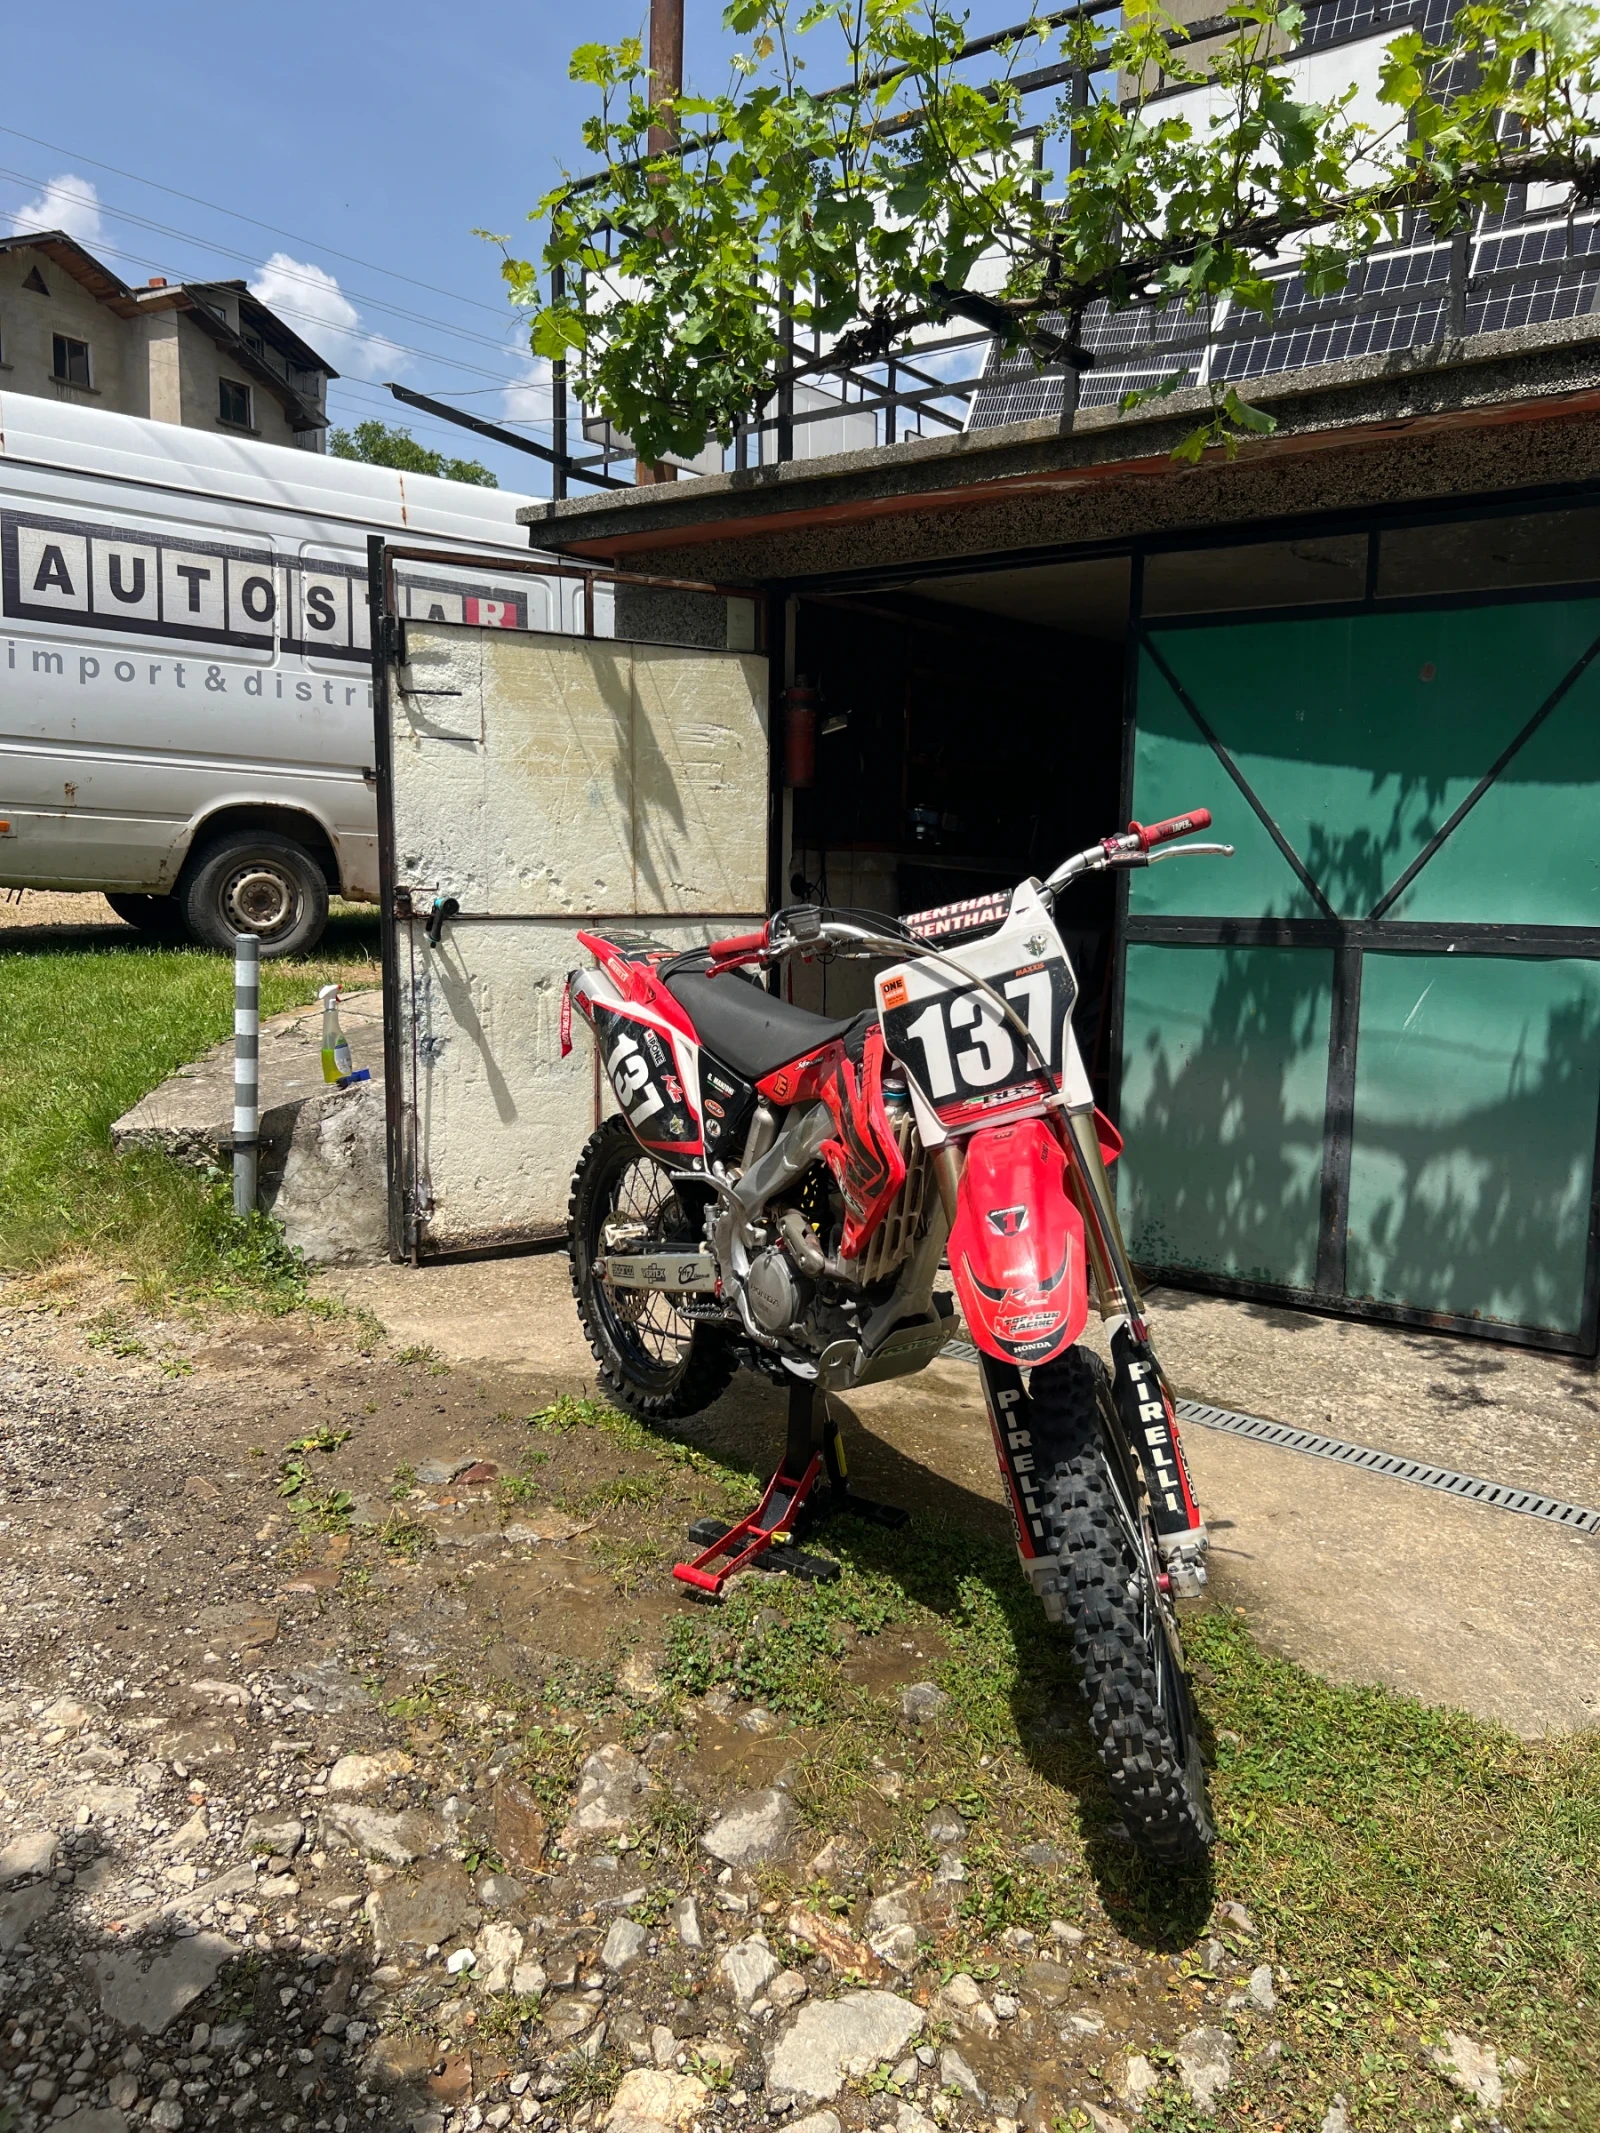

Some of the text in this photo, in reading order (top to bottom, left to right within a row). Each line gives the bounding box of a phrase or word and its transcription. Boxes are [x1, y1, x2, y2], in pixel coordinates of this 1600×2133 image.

[906, 892, 1006, 925] RENTHAL
[909, 906, 1009, 940] RENTHAL
[1016, 962, 1045, 976] MAXXIS
[883, 979, 903, 993] ONE
[562, 1010, 570, 1029] BEFORE
[906, 971, 1053, 1099] 137
[648, 1037, 665, 1066] IPONE
[607, 1033, 664, 1128] 137
[1002, 1212, 1019, 1234] 1
[641, 1267, 666, 1278] VERTEX
[1003, 1312, 1060, 1327] TOP GUN
[1009, 1319, 1054, 1333] RACING
[1013, 1341, 1052, 1353] HONDA
[1127, 1360, 1179, 1512] PIRELLI
[996, 1389, 1044, 1537] PIRELLI
